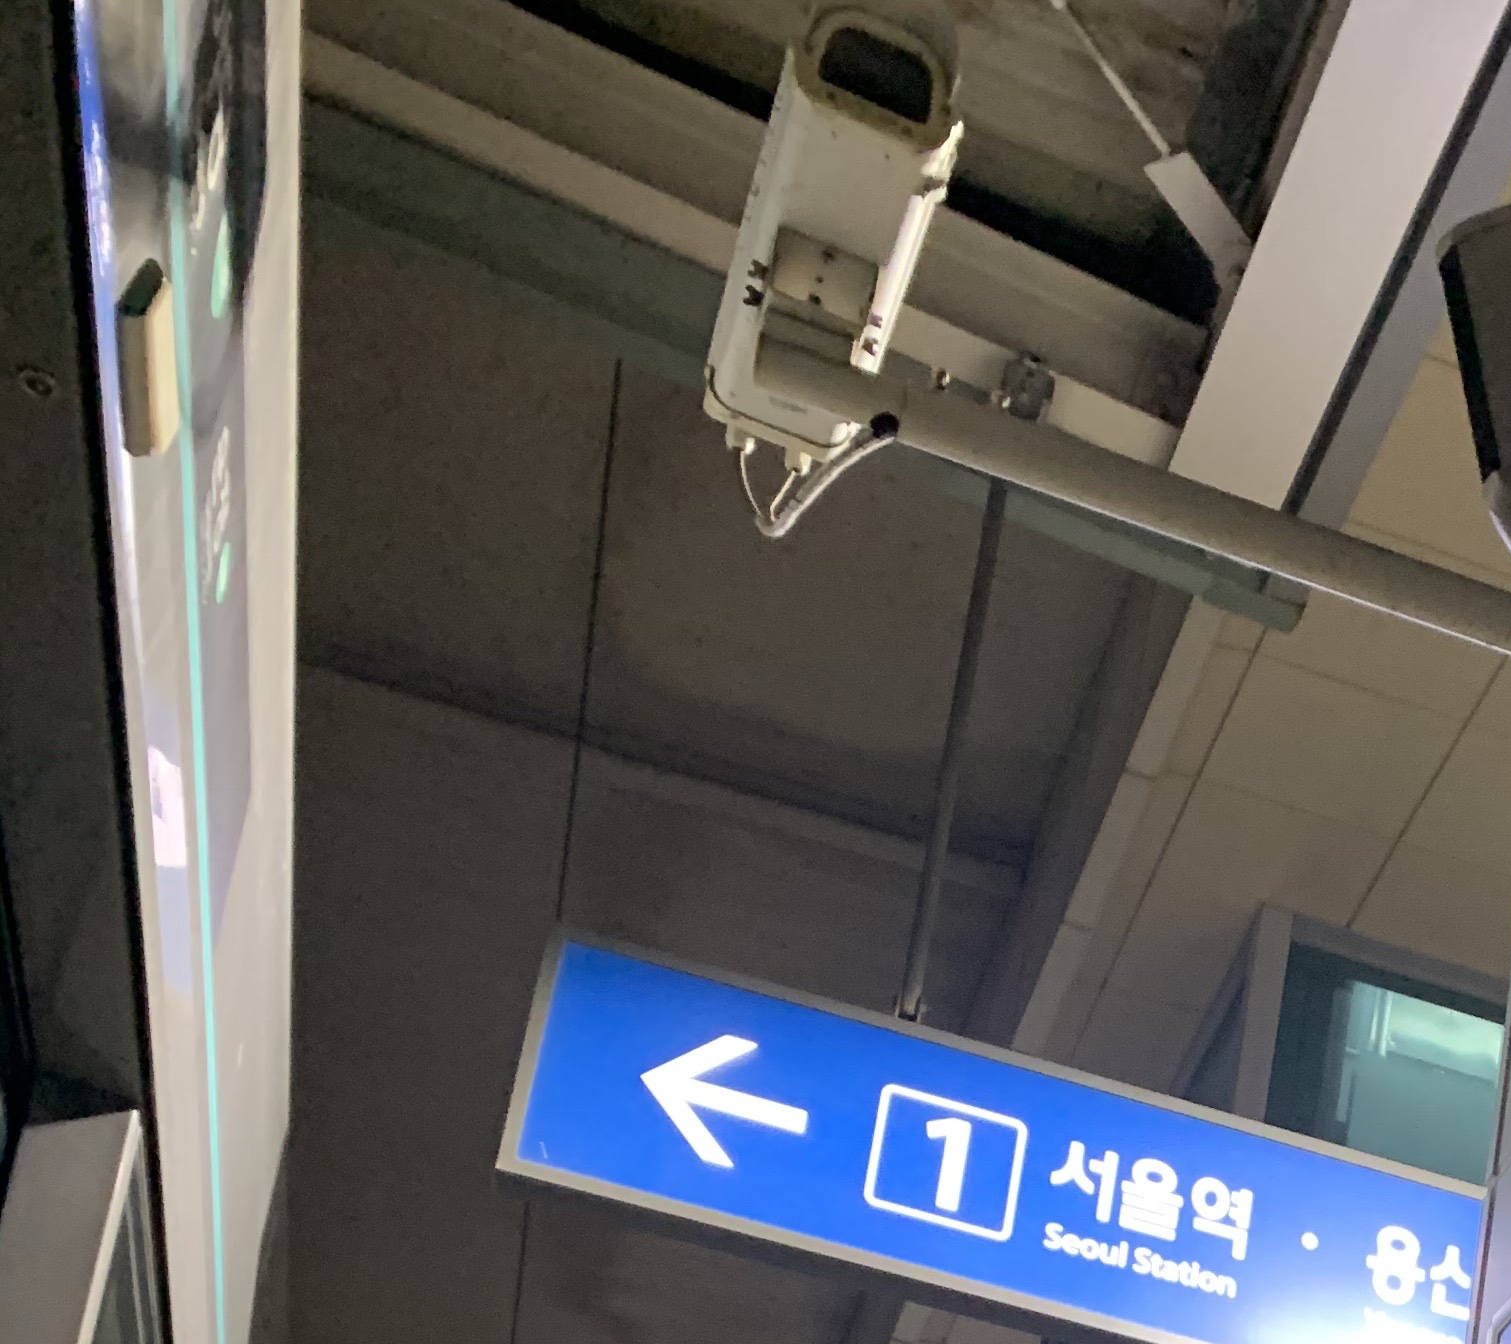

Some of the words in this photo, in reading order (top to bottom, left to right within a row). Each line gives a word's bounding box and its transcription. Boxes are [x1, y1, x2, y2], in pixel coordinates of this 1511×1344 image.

[925, 1117, 973, 1212] 1
[1049, 1139, 1255, 1262] 서울역
[1043, 1221, 1129, 1270] Seoul
[1132, 1246, 1238, 1299] Station
